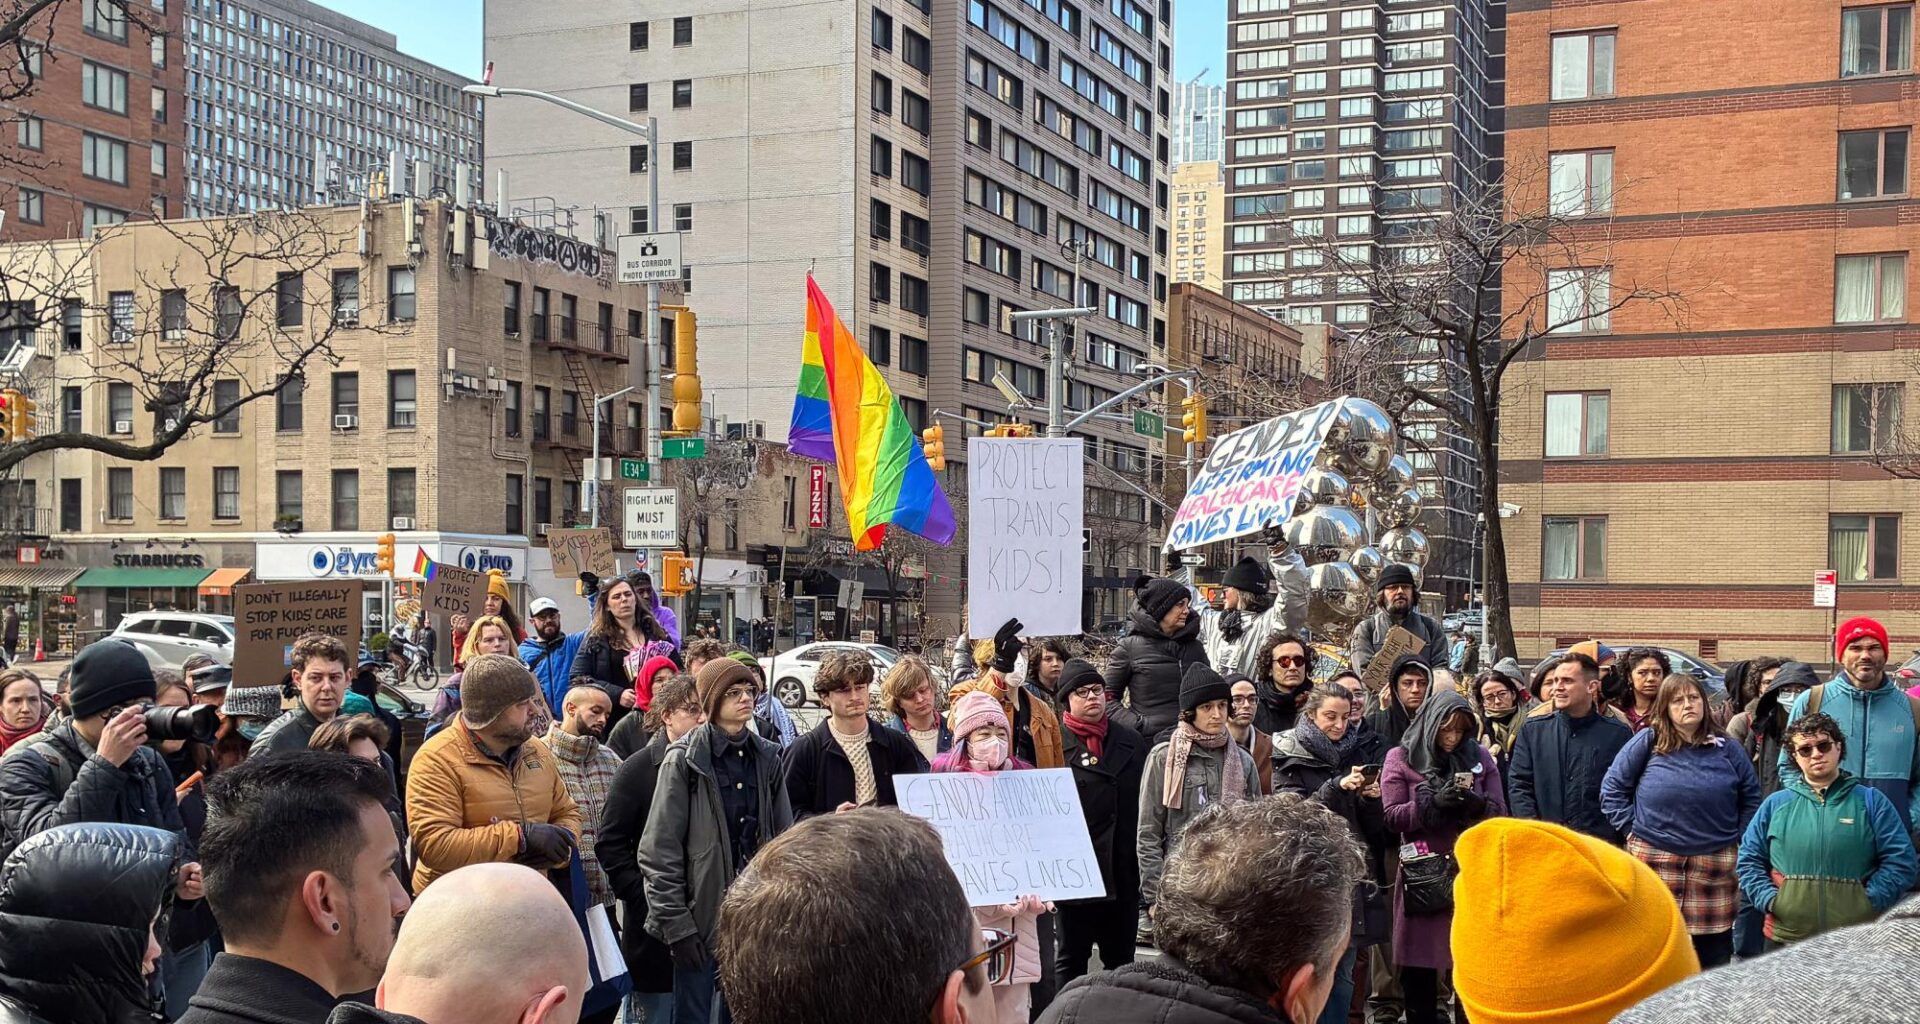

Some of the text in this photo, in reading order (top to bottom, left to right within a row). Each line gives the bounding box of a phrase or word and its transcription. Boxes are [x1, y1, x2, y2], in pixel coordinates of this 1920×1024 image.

[627, 259, 672, 269] BUS CORRIDOR
[623, 269, 677, 280] PHOTO ENFORCED
[1207, 402, 1337, 473] GENDER
[682, 441, 685, 455] 1
[624, 462, 629, 476] E
[630, 463, 640, 478] 34
[977, 441, 1079, 489] PROTECT
[627, 495, 675, 505] RIGHT LANE
[811, 469, 825, 524] PIZZA
[637, 512, 664, 524] MUST
[980, 497, 1071, 537] TRANS
[1172, 507, 1235, 545] SAVES
[627, 530, 675, 540] TURN RIGHT
[113, 553, 204, 568] STARBUCKS
[438, 566, 480, 585] PROTECT
[988, 546, 1063, 594] KIDS!
[289, 588, 351, 603] ILLEGALLY
[440, 582, 471, 597] TRANS
[434, 595, 470, 614] KIDS
[246, 610, 278, 624] STOP
[315, 607, 347, 620] CARE
[250, 628, 273, 641] FOR
[318, 624, 348, 637] SAKE
[1381, 638, 1402, 661] FIGHT
[906, 777, 991, 821] GENDER
[952, 858, 1093, 896] AVES LIVES!
